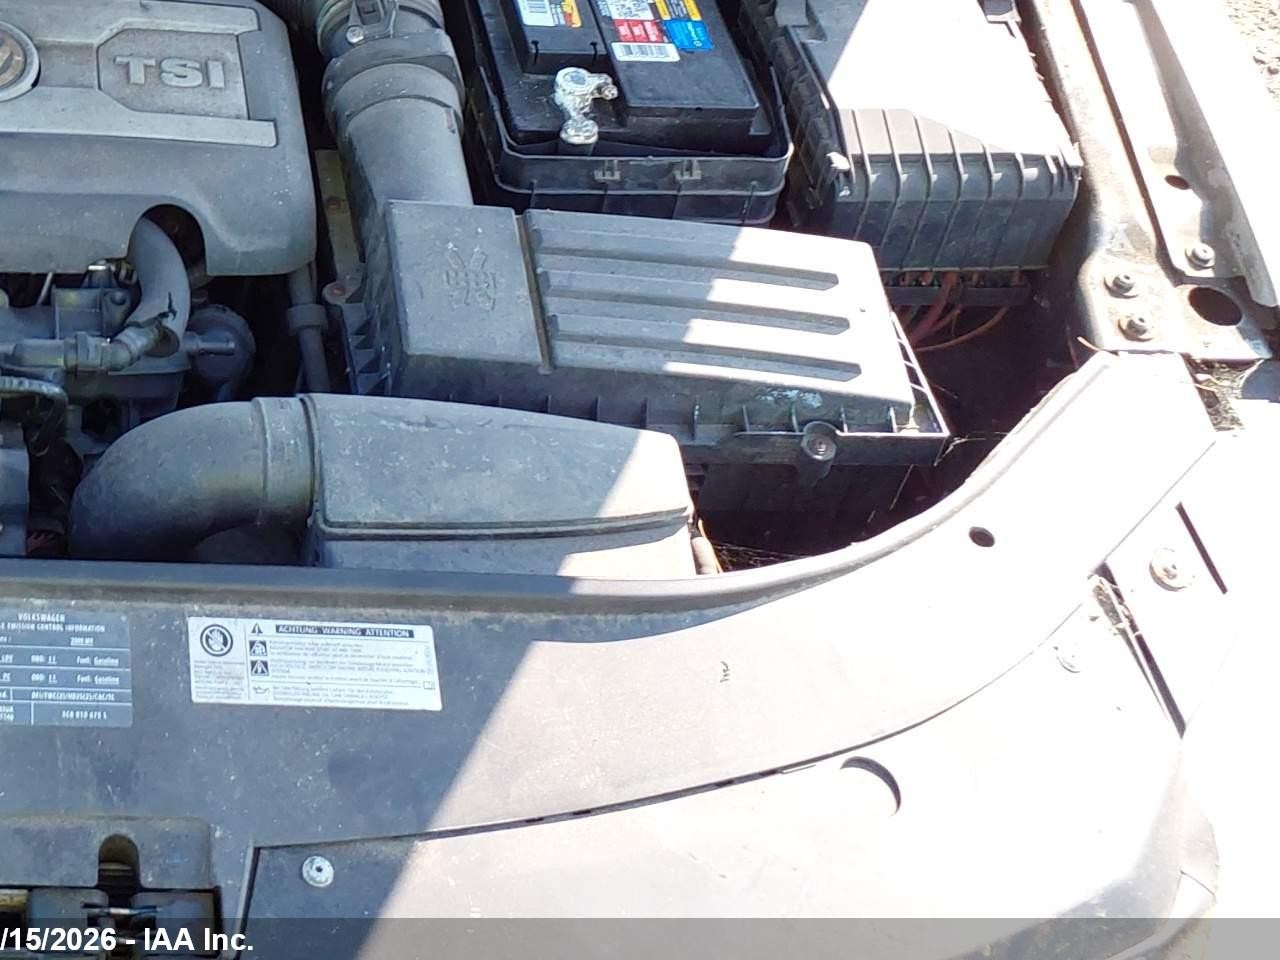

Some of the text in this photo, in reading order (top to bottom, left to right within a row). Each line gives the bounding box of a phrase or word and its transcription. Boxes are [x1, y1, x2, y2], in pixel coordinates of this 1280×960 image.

[115, 55, 227, 89] TSI
[18, 613, 66, 622] VOLKSWAGEN
[37, 623, 64, 632] CONTROL
[65, 624, 105, 633] INFORMATION
[278, 625, 410, 638] ACHTUNG WARNING ATTENTION
